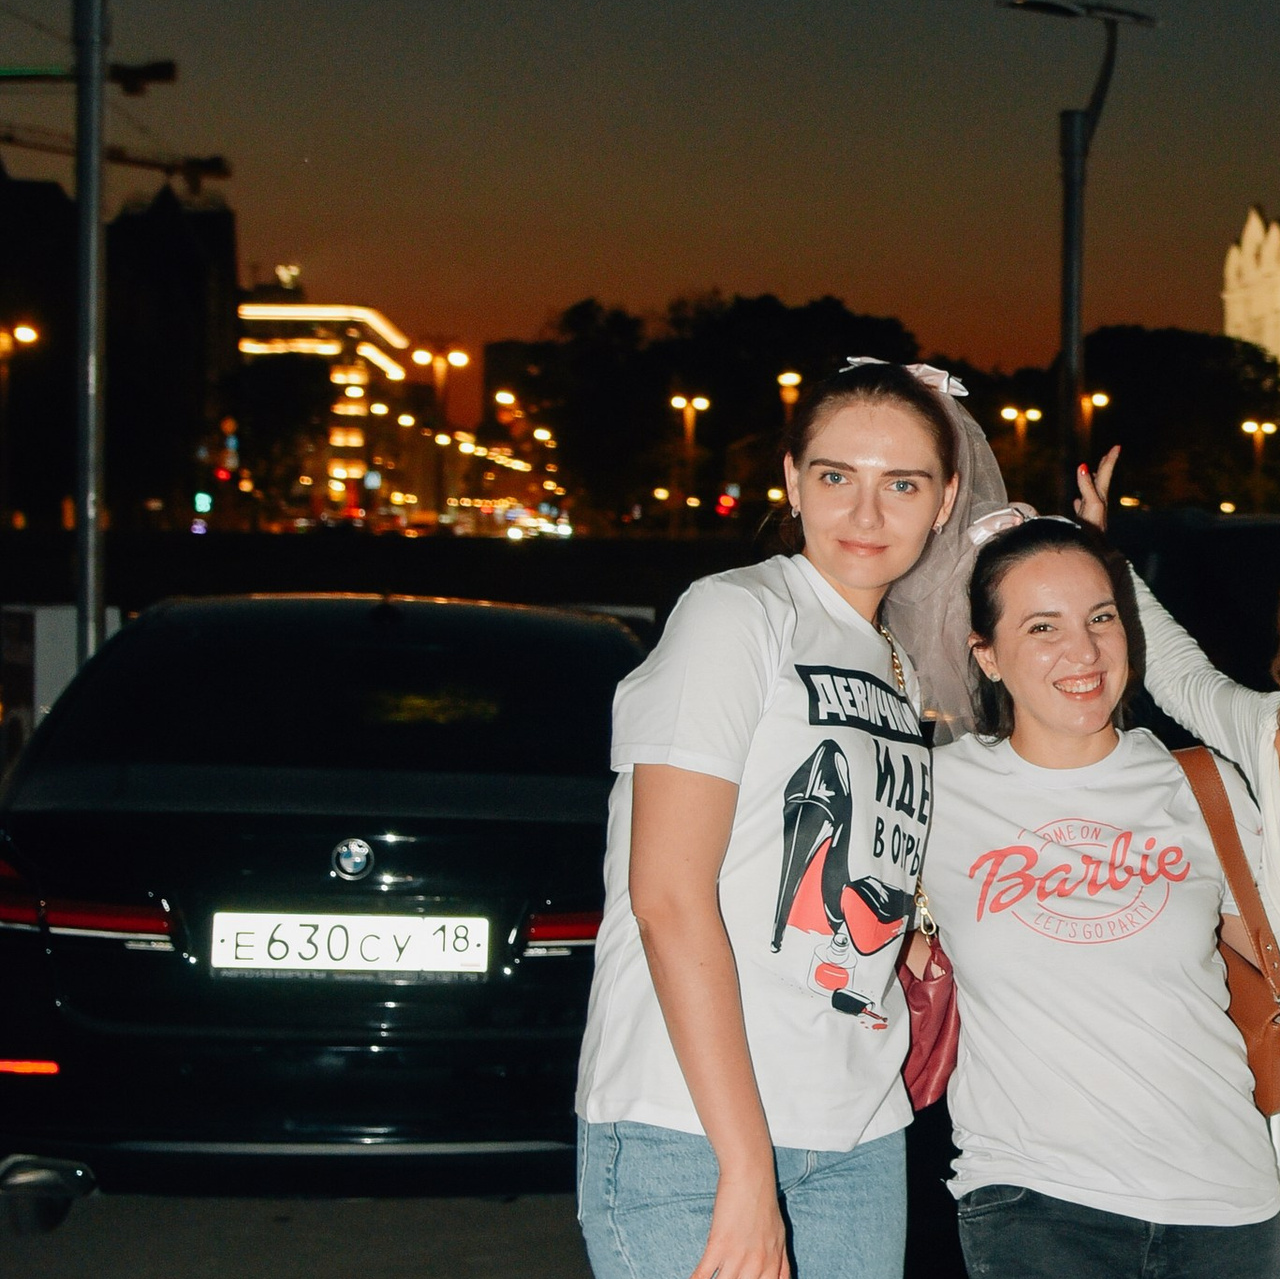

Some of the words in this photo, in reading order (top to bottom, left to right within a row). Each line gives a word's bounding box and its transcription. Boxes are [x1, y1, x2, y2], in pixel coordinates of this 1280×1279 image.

[873, 816, 885, 859] В
[1080, 825, 1102, 841] ON
[968, 831, 1191, 923] Barbie
[432, 924, 470, 953] 18
[1033, 912, 1078, 939] LET'S
[1082, 923, 1103, 940] GO
[1107, 901, 1154, 937] PARTY
